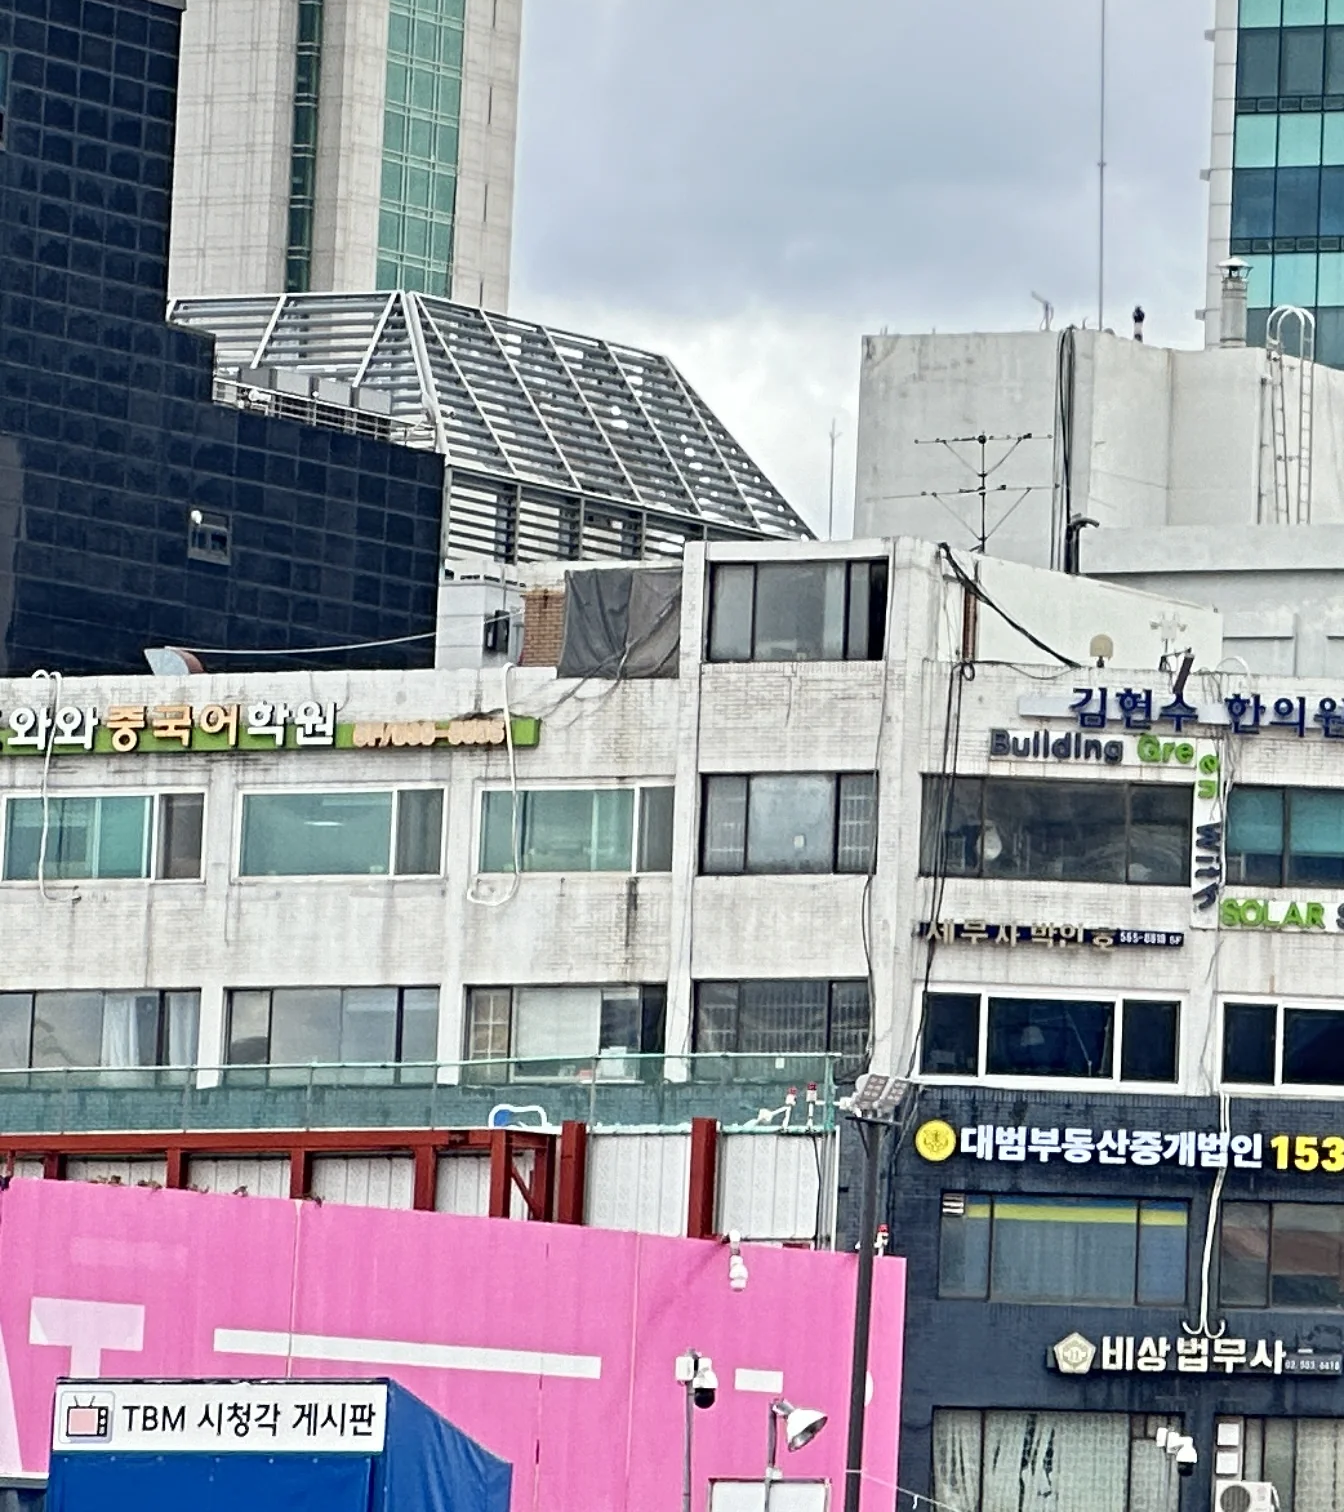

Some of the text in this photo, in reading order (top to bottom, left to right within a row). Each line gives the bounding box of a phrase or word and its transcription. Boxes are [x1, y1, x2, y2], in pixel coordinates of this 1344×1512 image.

[1070, 687, 1198, 733] 김현수
[989, 728, 1124, 765] Building
[1221, 897, 1325, 930] SOLAR
[925, 918, 1021, 948] 세무사
[959, 1124, 1263, 1170] 대범부동산중개법인
[122, 1402, 377, 1438] TBM 시청각 게시판
